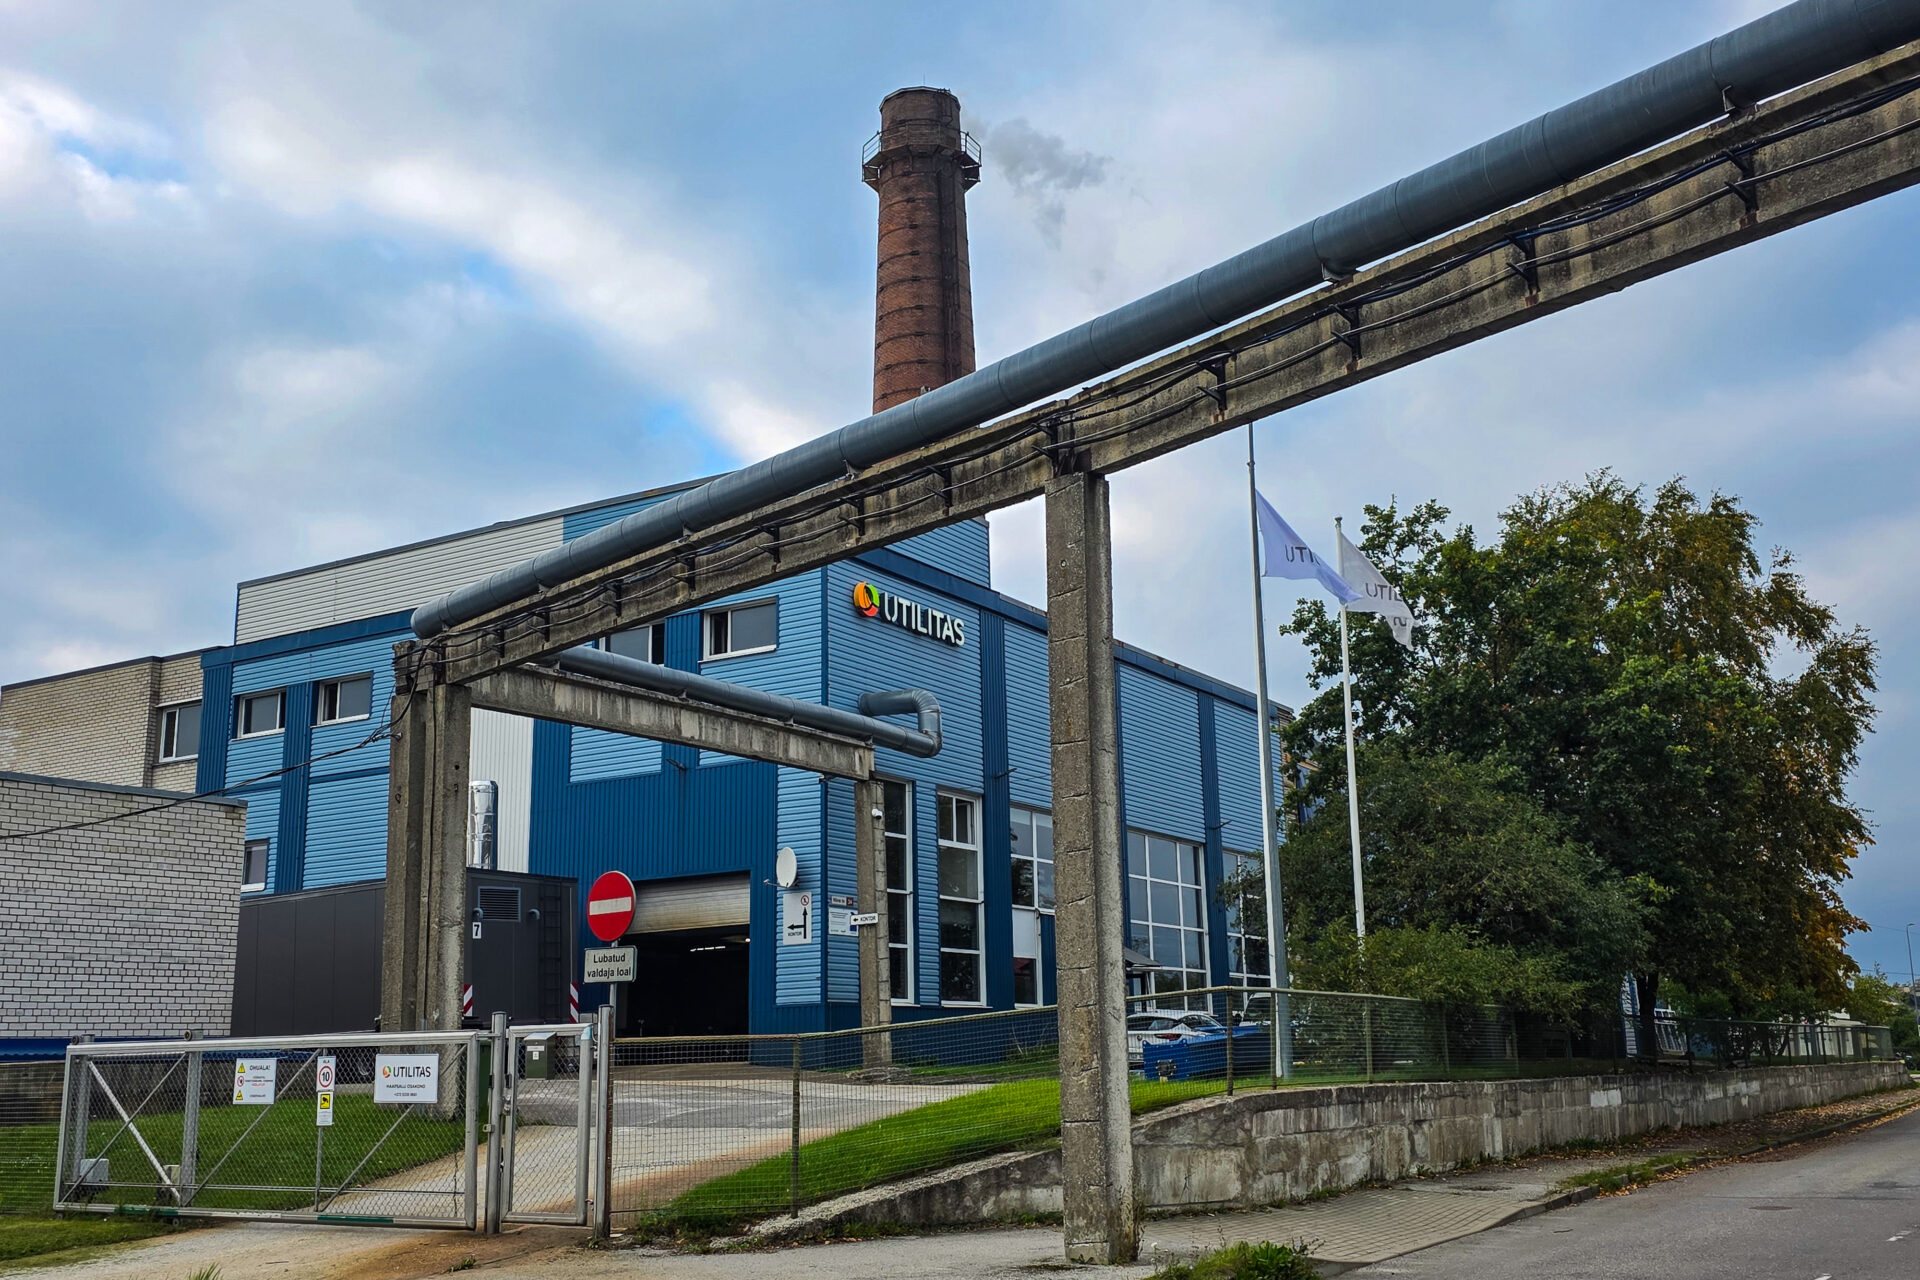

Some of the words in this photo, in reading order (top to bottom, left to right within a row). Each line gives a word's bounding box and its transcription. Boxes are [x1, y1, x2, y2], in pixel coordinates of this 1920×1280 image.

[883, 591, 965, 646] UTILITAS
[474, 924, 480, 936] 7
[593, 953, 626, 963] Lubatud
[587, 968, 615, 979] valdaja
[616, 966, 632, 977] loal
[322, 1071, 330, 1082] 10
[393, 1066, 431, 1078] UTILITAS
